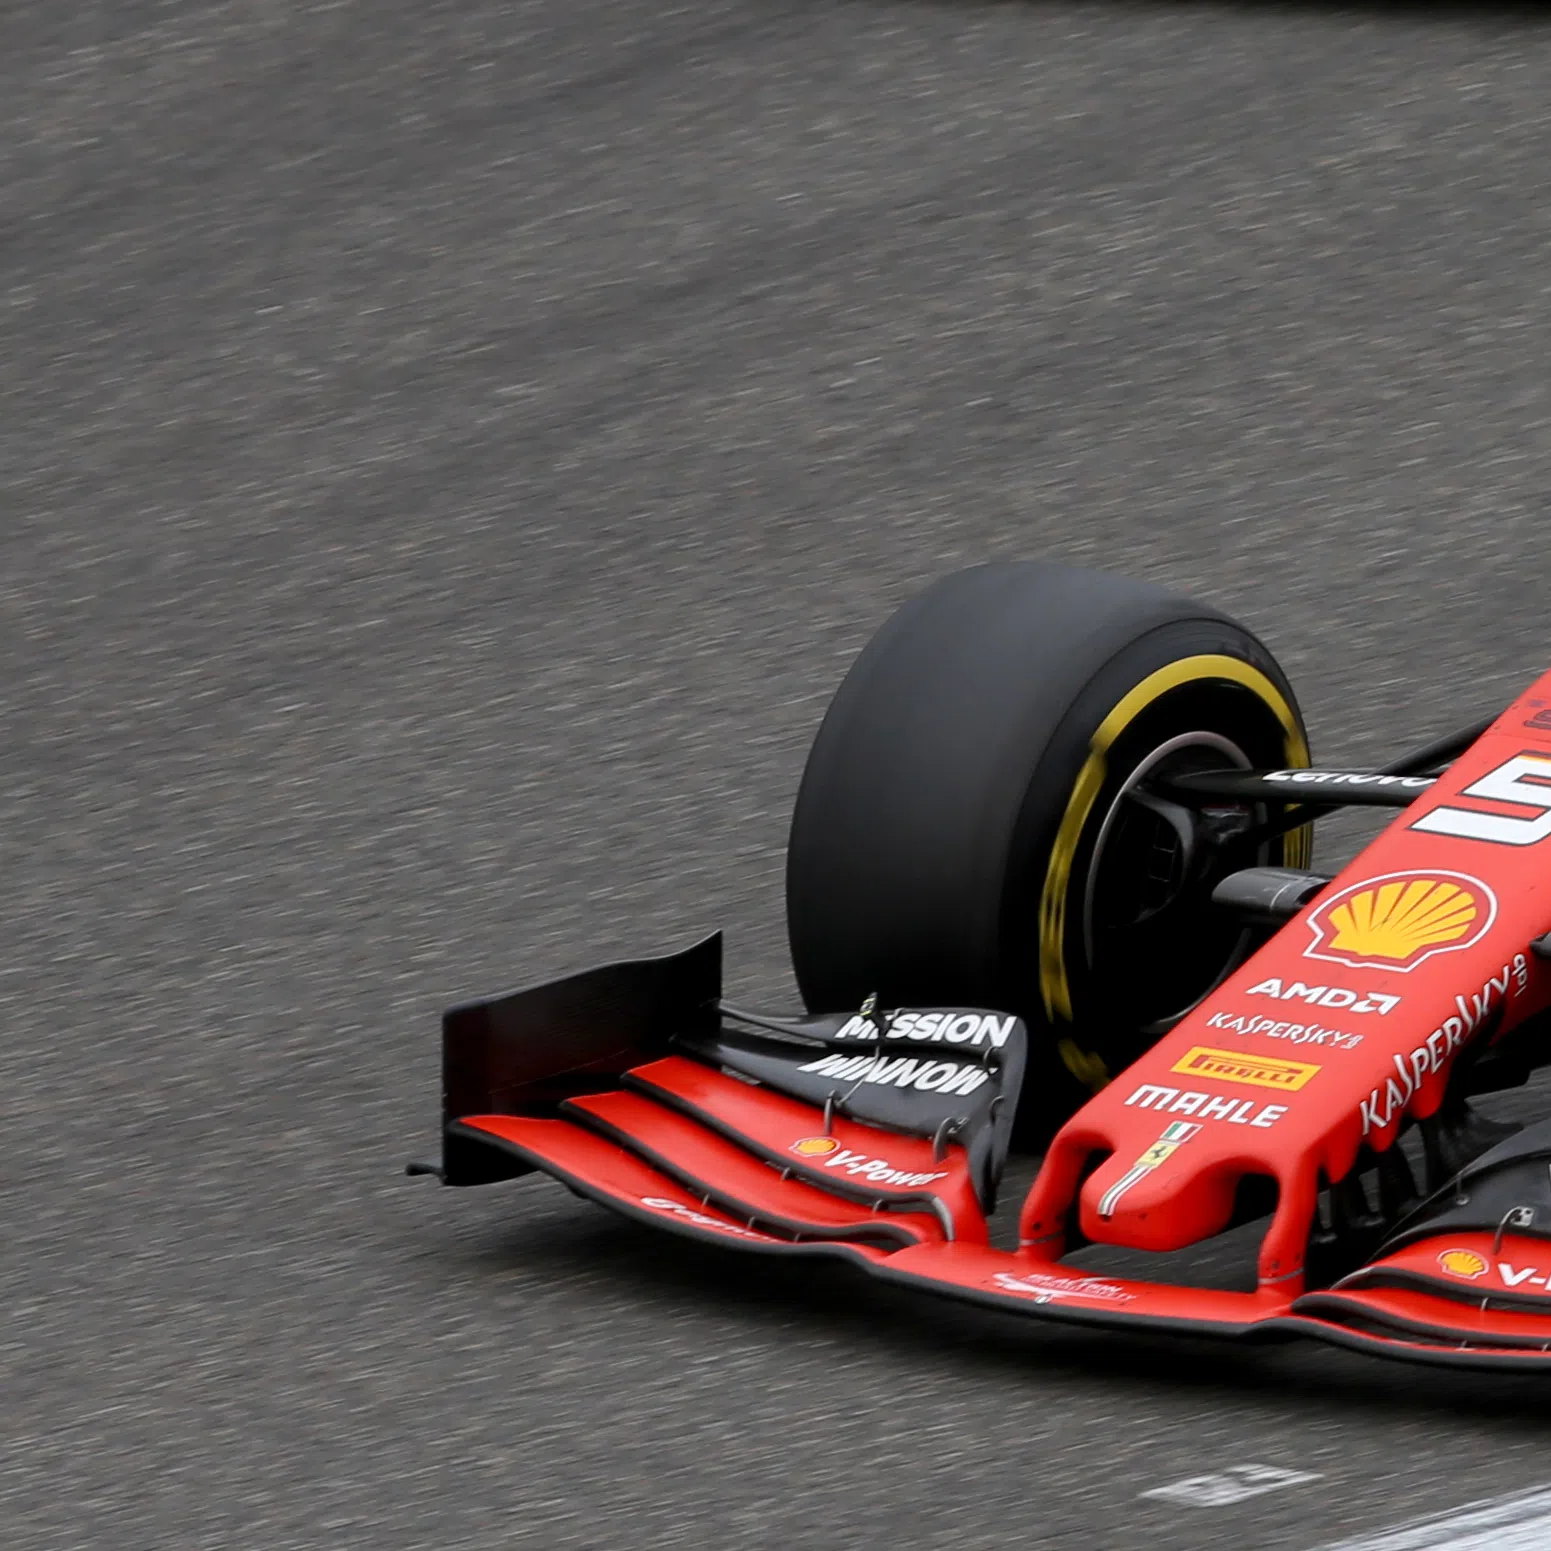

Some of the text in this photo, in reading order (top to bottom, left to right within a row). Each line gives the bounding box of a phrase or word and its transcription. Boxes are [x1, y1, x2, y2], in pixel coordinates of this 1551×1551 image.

[1245, 978, 1358, 1009] AMD
[834, 1012, 1018, 1048] MSSION
[1206, 1011, 1349, 1049] KASPERSKY
[1358, 961, 1511, 1140] KASPERSKY
[796, 1053, 999, 1096] WINNOW
[824, 1149, 948, 1187] V-Power
